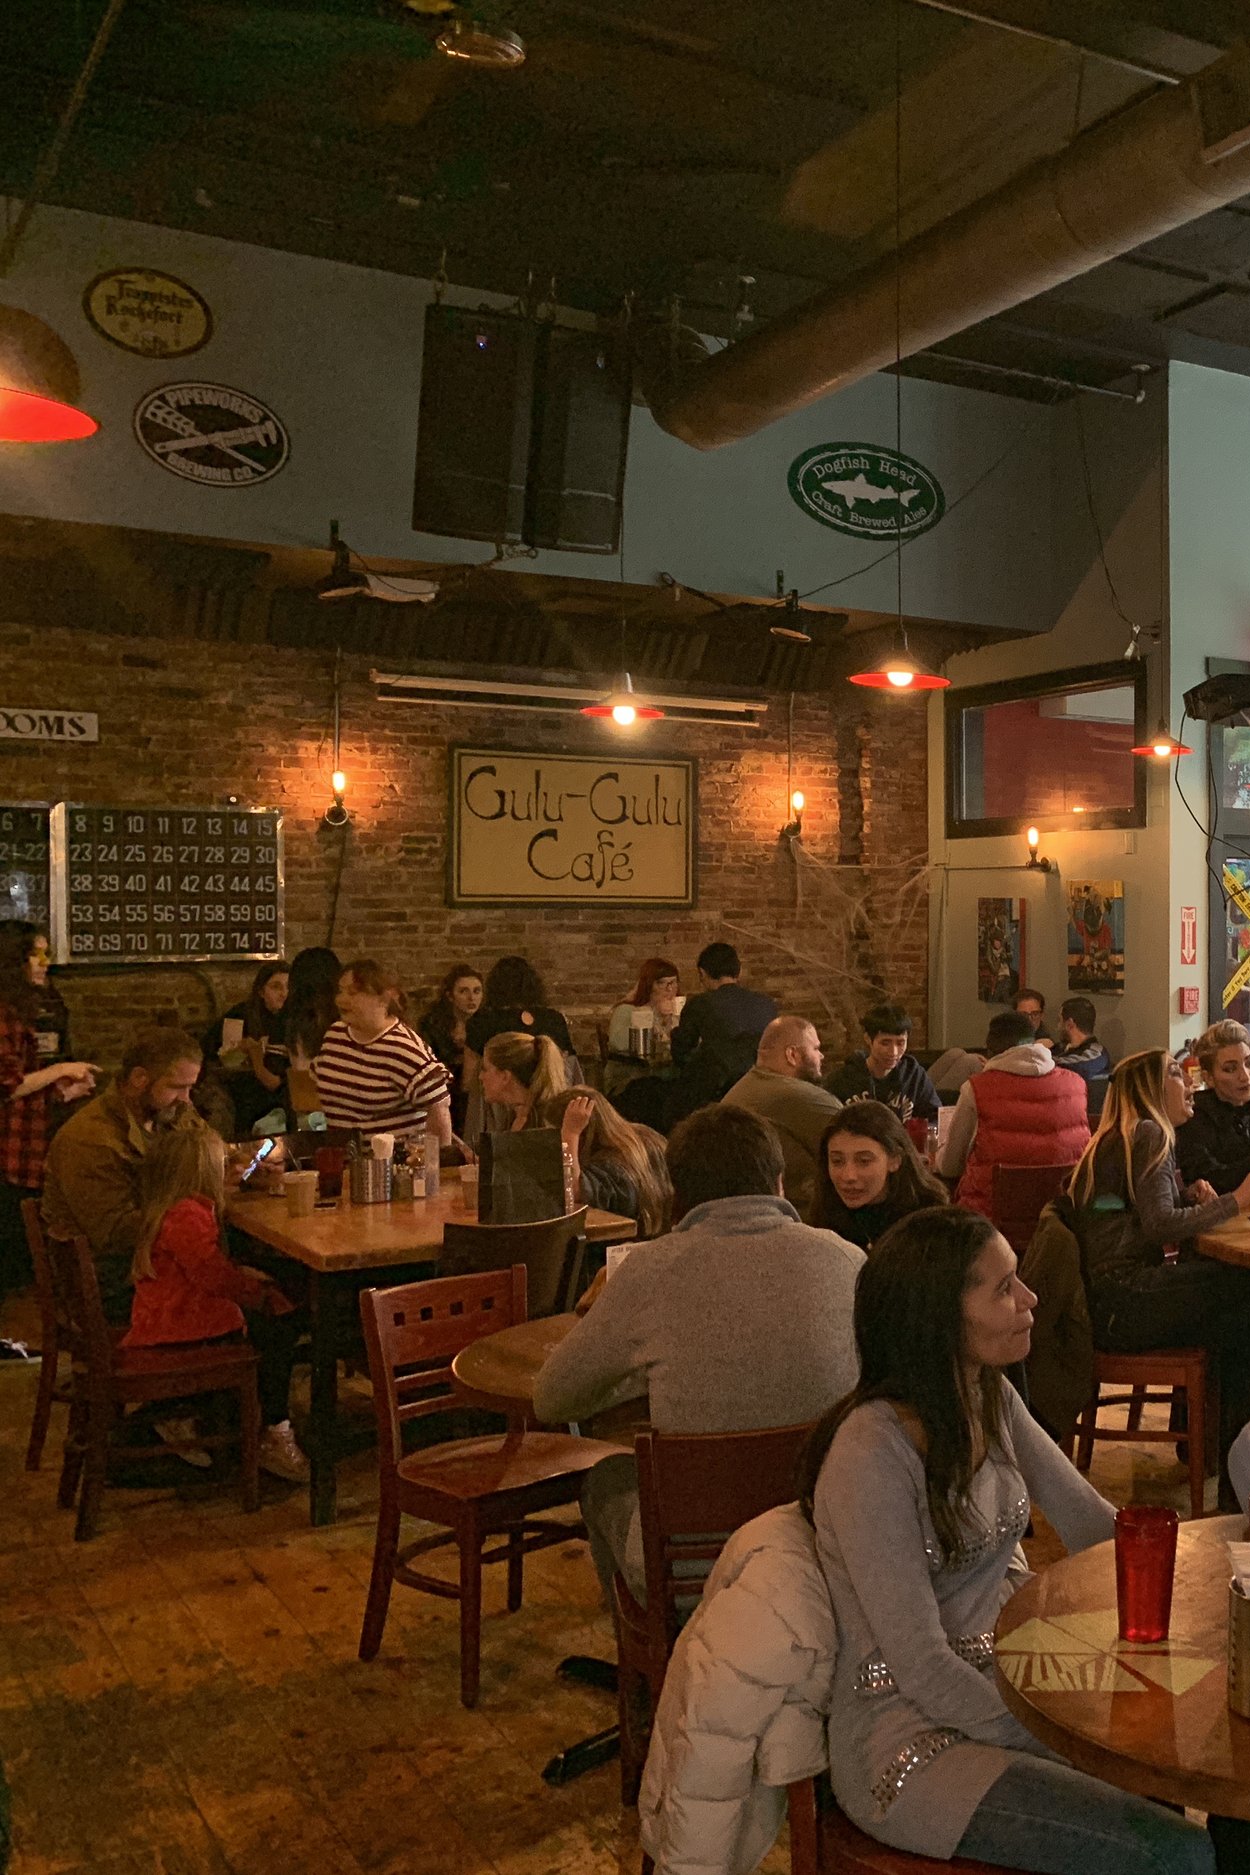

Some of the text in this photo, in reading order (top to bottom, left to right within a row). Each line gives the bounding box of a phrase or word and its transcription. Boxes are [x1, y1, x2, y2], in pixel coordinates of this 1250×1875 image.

[105, 294, 183, 324] Rochefort
[164, 388, 264, 423] PIPEWORKS
[166, 452, 231, 481] BREWING
[812, 456, 917, 486] Dogfish Head
[812, 491, 927, 528] Craft Brewed Ales
[464, 765, 682, 826] Gulu-Gulu
[1, 813, 273, 836] 6 7 8 9 10 11 12 13 14 15
[70, 845, 92, 862] 23
[98, 845, 118, 862] 24
[124, 845, 146, 863] 25
[153, 846, 174, 863] 26
[179, 846, 199, 863] 27
[205, 847, 225, 863] 28
[230, 847, 250, 863] 29
[255, 847, 275, 864] 30
[527, 828, 634, 889] Café
[70, 874, 92, 892] 38
[98, 874, 119, 892] 39
[125, 875, 146, 892] 40
[155, 875, 172, 892] 41
[180, 875, 200, 892] 42
[204, 875, 225, 892] 43
[229, 876, 250, 892] 44
[255, 876, 275, 892] 45
[72, 905, 93, 922] 53
[100, 905, 121, 922] 54
[125, 905, 148, 922] 55
[153, 905, 175, 922] 56
[179, 905, 200, 922] 57
[204, 905, 225, 922] 58
[230, 905, 250, 922] 59
[255, 905, 275, 922] 60
[72, 933, 275, 952] 68 69 70 71 72 73 74 75
